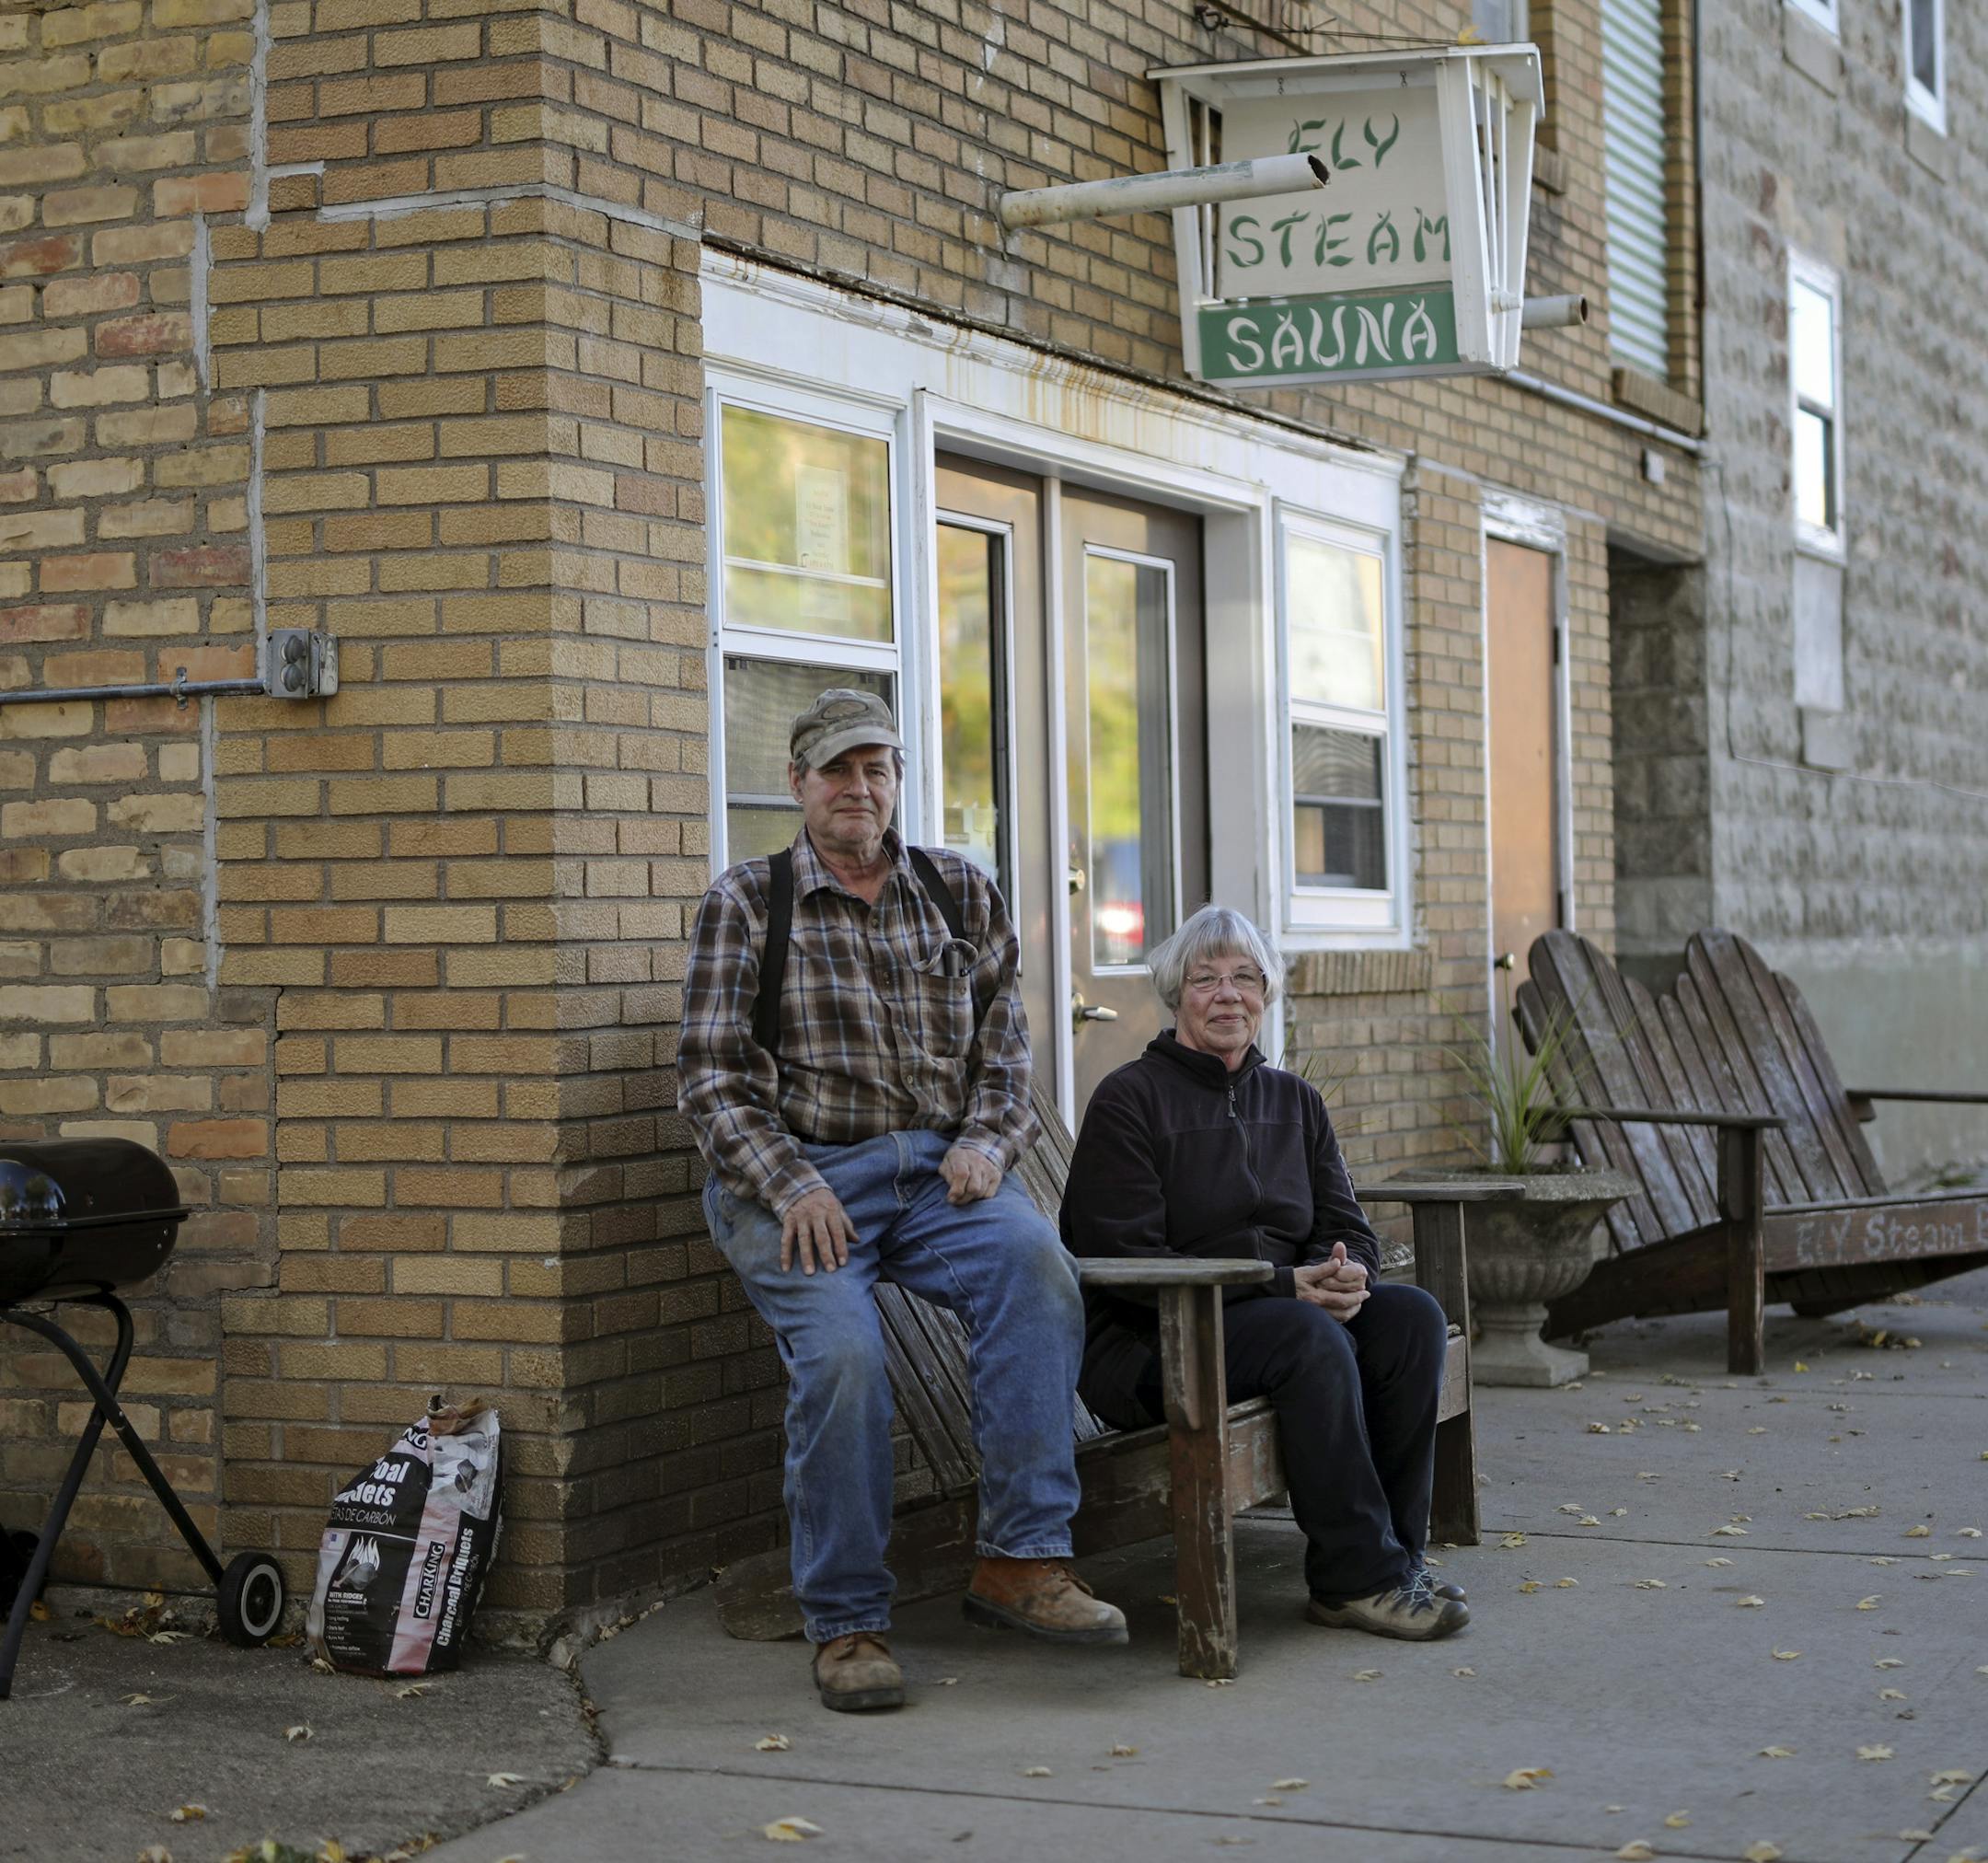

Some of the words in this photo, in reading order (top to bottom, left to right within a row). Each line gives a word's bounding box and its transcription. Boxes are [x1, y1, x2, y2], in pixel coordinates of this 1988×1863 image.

[1288, 111, 1399, 169] ELY
[1225, 206, 1451, 269] STEAM
[1226, 296, 1438, 372] SAUNA
[1863, 1212, 1963, 1257] Steam
[355, 1510, 398, 1526] CARBÓN
[415, 1545, 445, 1617] CHARKING
[436, 1585, 461, 1647] Charcoal
[449, 1528, 474, 1586] Briquets
